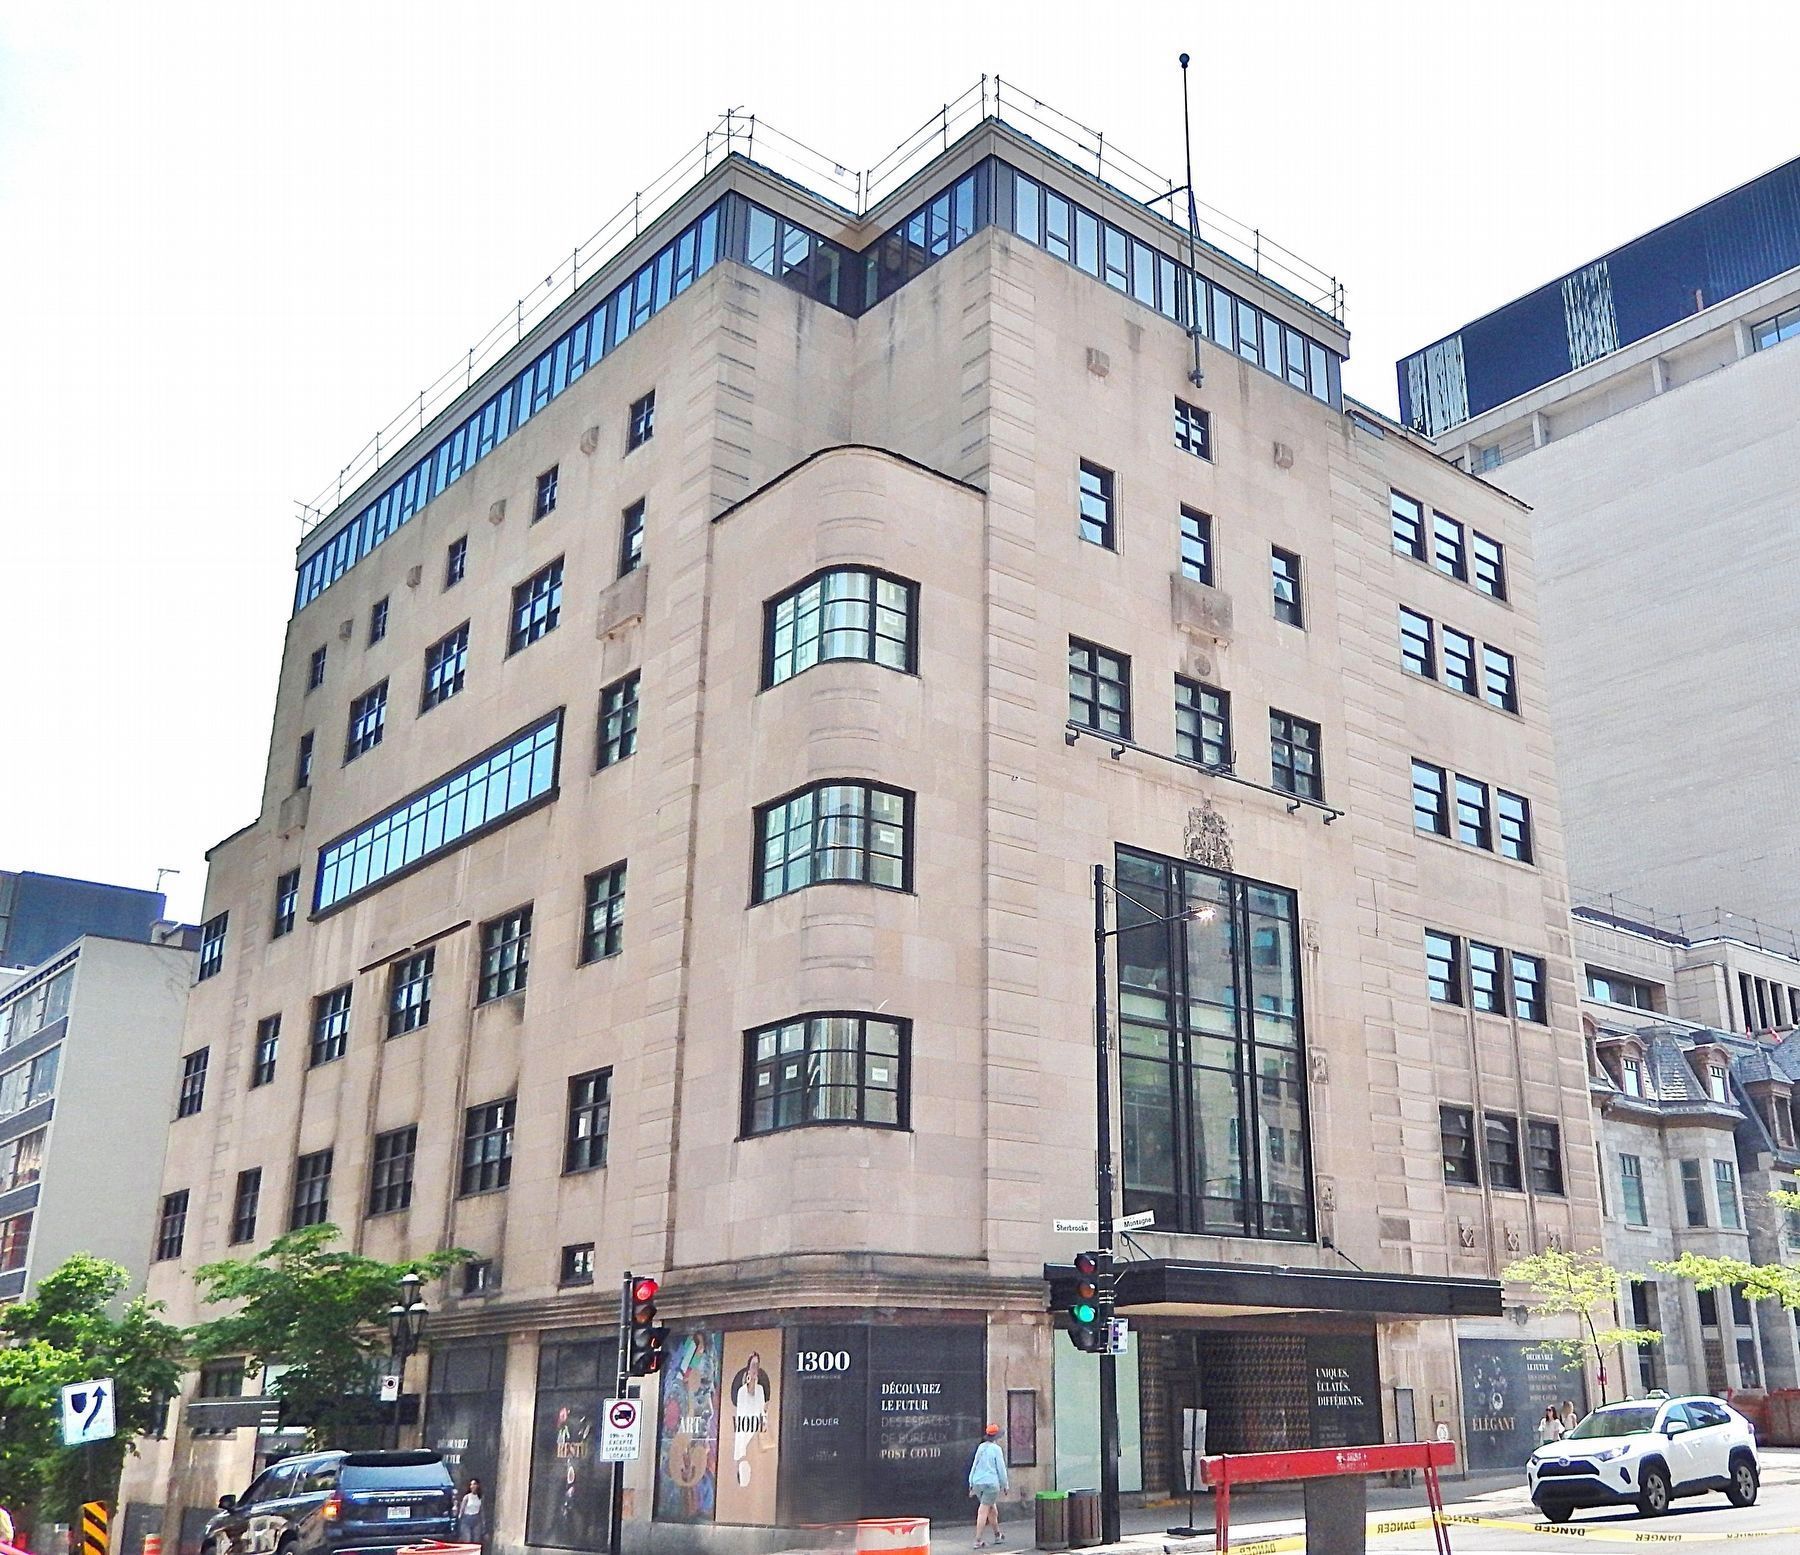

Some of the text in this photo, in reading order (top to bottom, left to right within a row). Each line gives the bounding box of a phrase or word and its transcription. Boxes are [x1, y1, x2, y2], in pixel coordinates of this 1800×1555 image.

[1056, 1224, 1088, 1232] Sherbrooke
[1124, 1217, 1152, 1227] Montagne
[796, 1351, 850, 1371] 1300
[881, 1382, 941, 1394] DÉCOUVREZ
[881, 1400, 928, 1411] LE FUTUR
[732, 1415, 767, 1433] MODE
[881, 1447, 941, 1459] POST COVID
[1534, 1524, 1585, 1536] DANGER
[1636, 1533, 1681, 1542] DANGER
